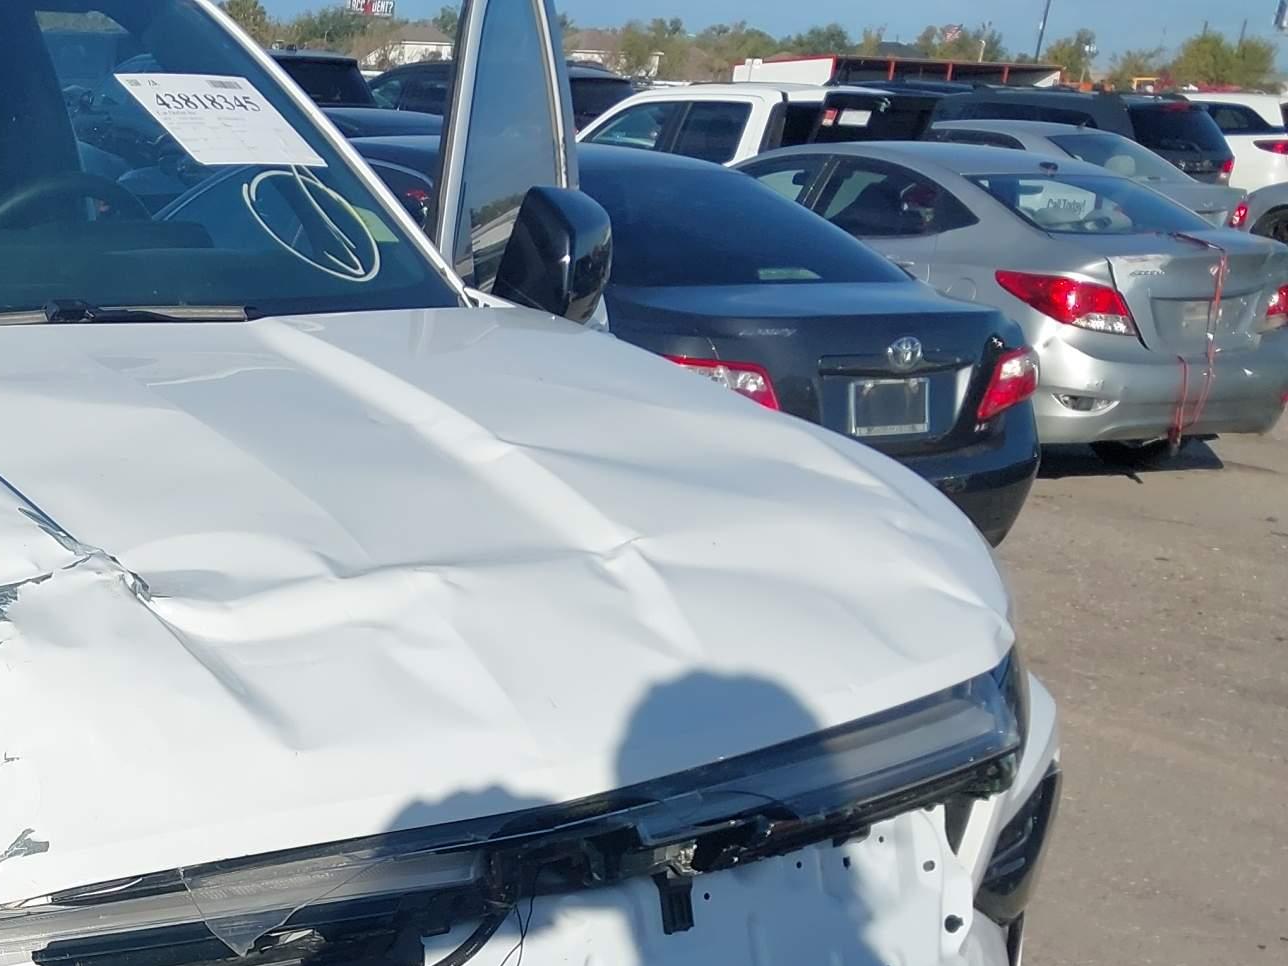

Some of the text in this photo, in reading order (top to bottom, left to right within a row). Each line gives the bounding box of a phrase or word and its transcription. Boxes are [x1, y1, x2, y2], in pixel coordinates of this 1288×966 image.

[352, 0, 394, 13] ACCDENT?
[155, 93, 261, 112] 43818345
[1047, 198, 1062, 209] Call
